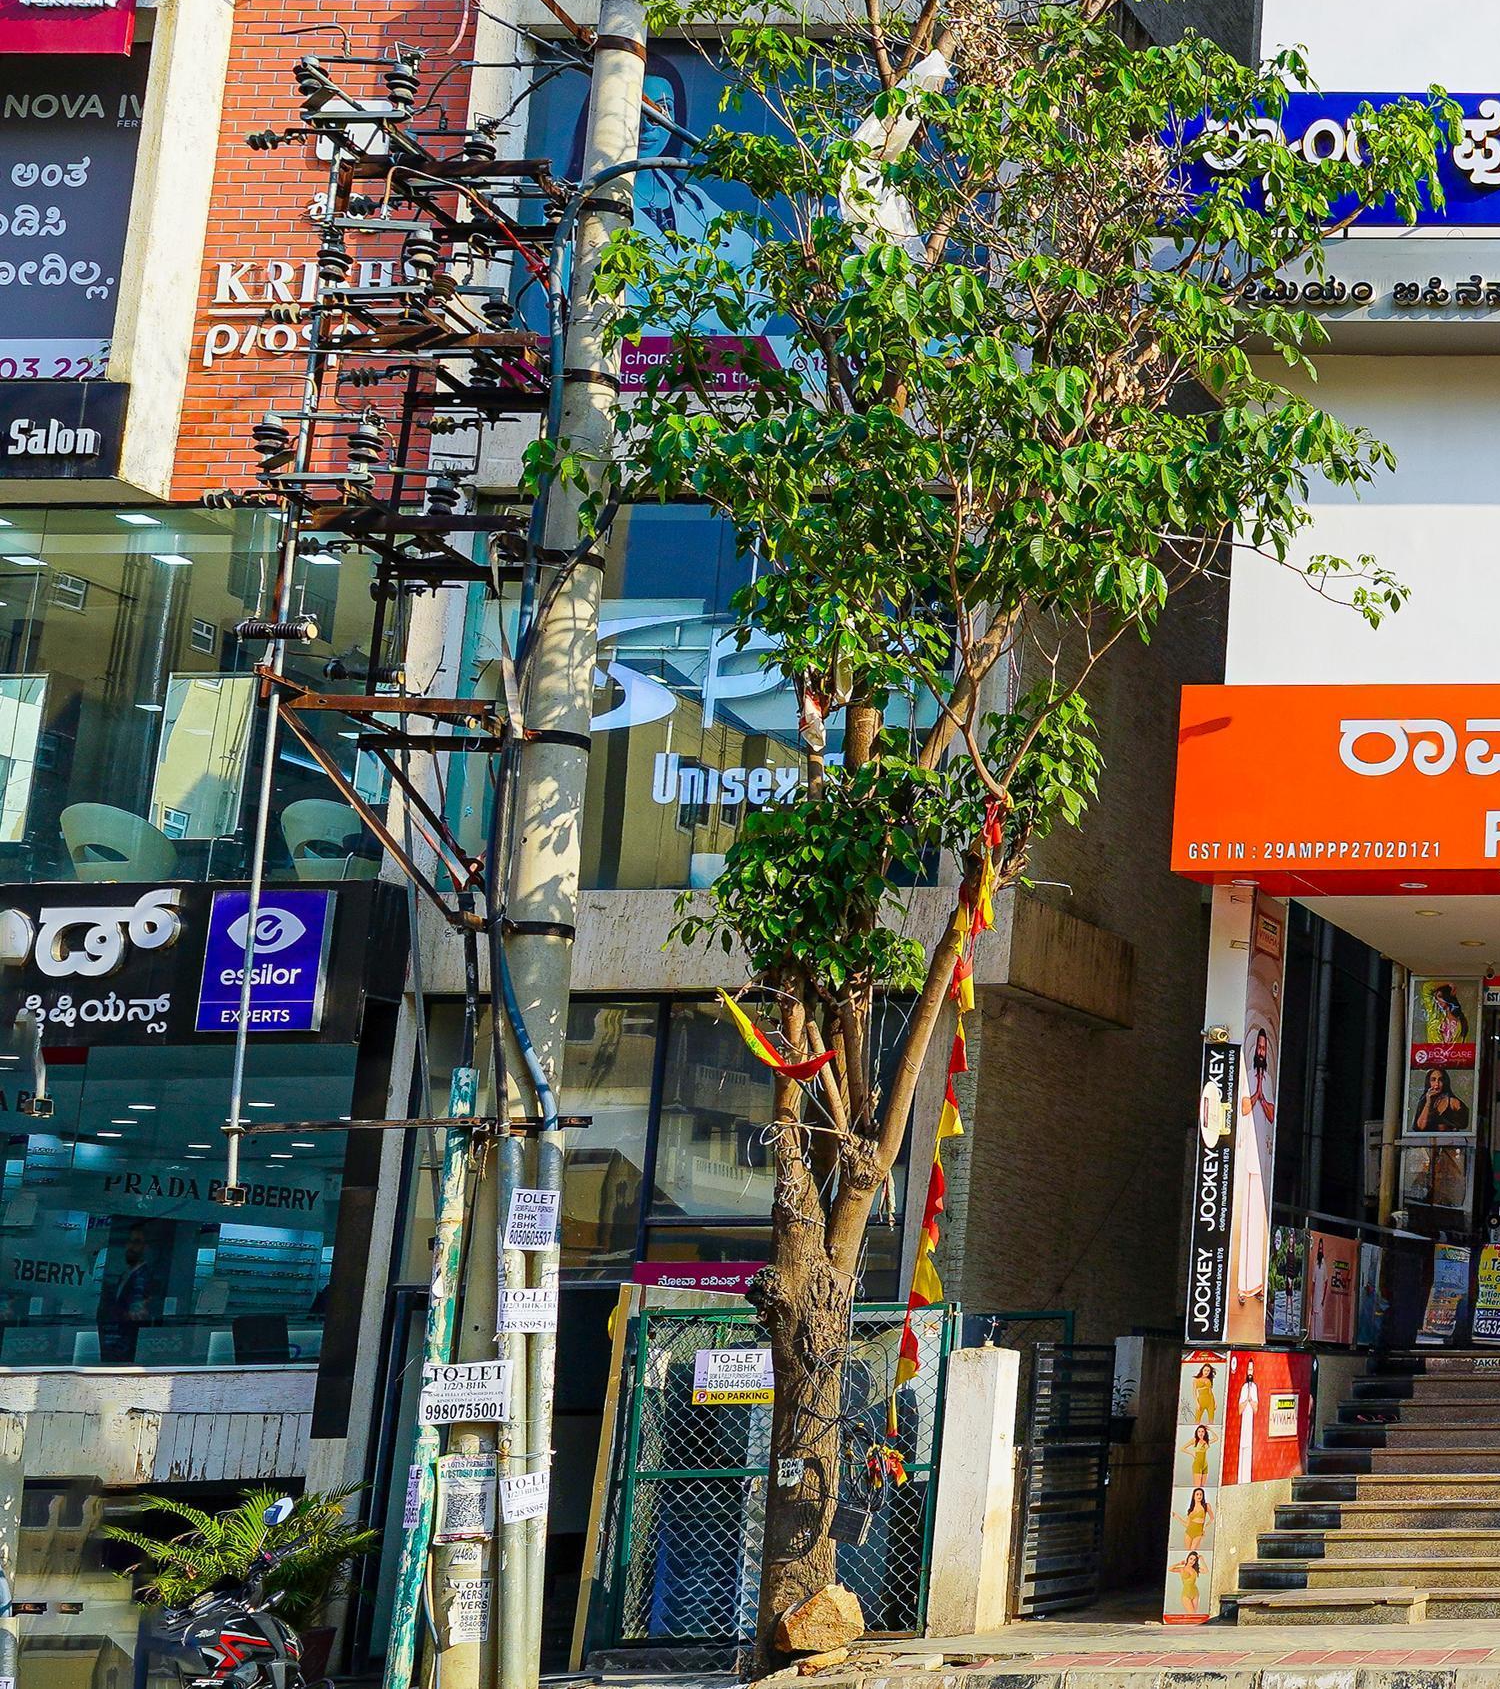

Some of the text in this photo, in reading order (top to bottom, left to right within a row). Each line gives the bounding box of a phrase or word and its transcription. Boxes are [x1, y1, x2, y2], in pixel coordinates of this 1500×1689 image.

[4, 94, 105, 119] NOVA
[8, 419, 99, 457] Salon
[1188, 842, 1221, 859] GST
[1227, 842, 1245, 859] IN
[104, 1171, 320, 1211] PRADA BRBERRY
[516, 1192, 556, 1205] TOLET
[1200, 1148, 1220, 1232] JOCKEY
[512, 1213, 537, 1221] 1BHK
[502, 1291, 557, 1302] TO-LE
[1194, 1247, 1214, 1333] JOCKEY
[712, 1353, 764, 1363] TO-LET
[430, 1365, 506, 1382] TO-LET
[711, 1392, 769, 1401] NO PARKING
[425, 1402, 504, 1421] 9980755001
